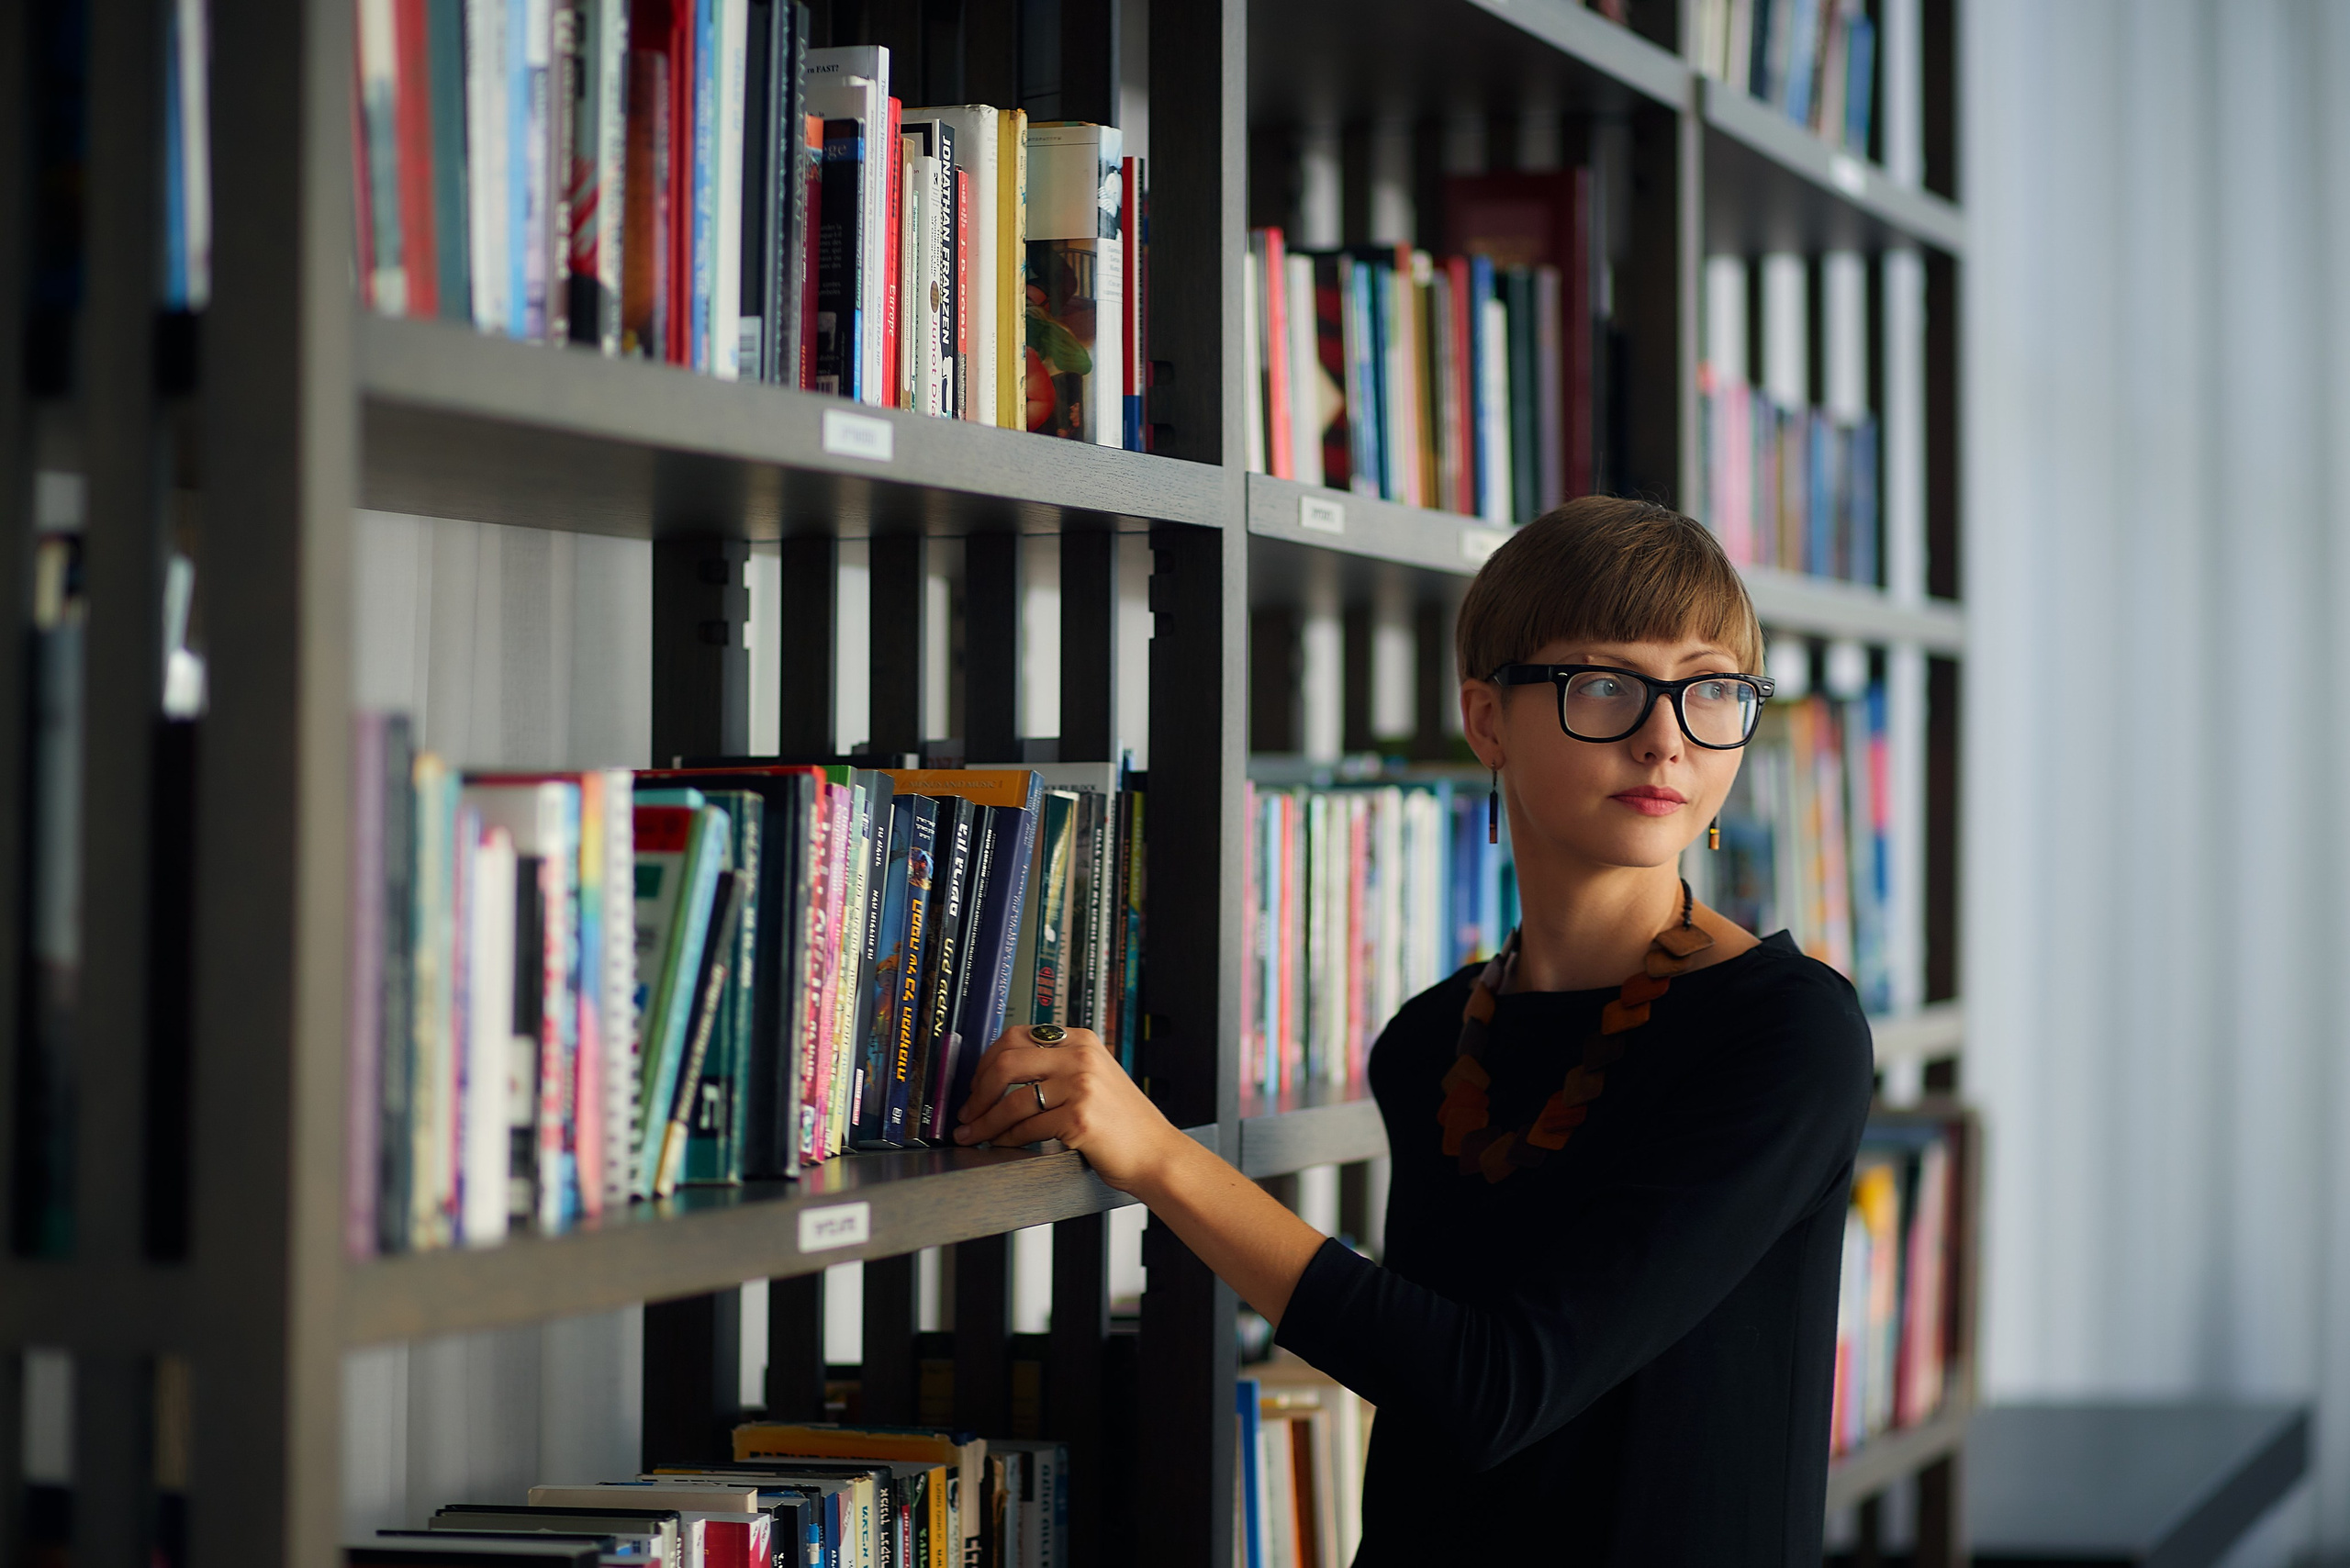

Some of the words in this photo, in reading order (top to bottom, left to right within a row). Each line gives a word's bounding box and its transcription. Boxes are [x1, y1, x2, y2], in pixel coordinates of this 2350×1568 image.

[816, 64, 839, 73] FAST?
[942, 135, 951, 241] JONATHAN
[887, 284, 896, 338] Europe
[942, 246, 950, 345] FRANZEN
[944, 780, 964, 789] AND
[966, 780, 997, 789] MUSIC
[957, 823, 968, 853] ג'ון
[949, 857, 964, 917] גרישם
[909, 898, 923, 951] המפה
[907, 953, 919, 975] של
[941, 937, 955, 976] תיק
[902, 977, 915, 1002] כל
[933, 979, 948, 1037] שקנאי
[896, 1006, 912, 1082] המקומות
[879, 1487, 891, 1526] אמנון
[879, 1531, 891, 1568] דנקנר
